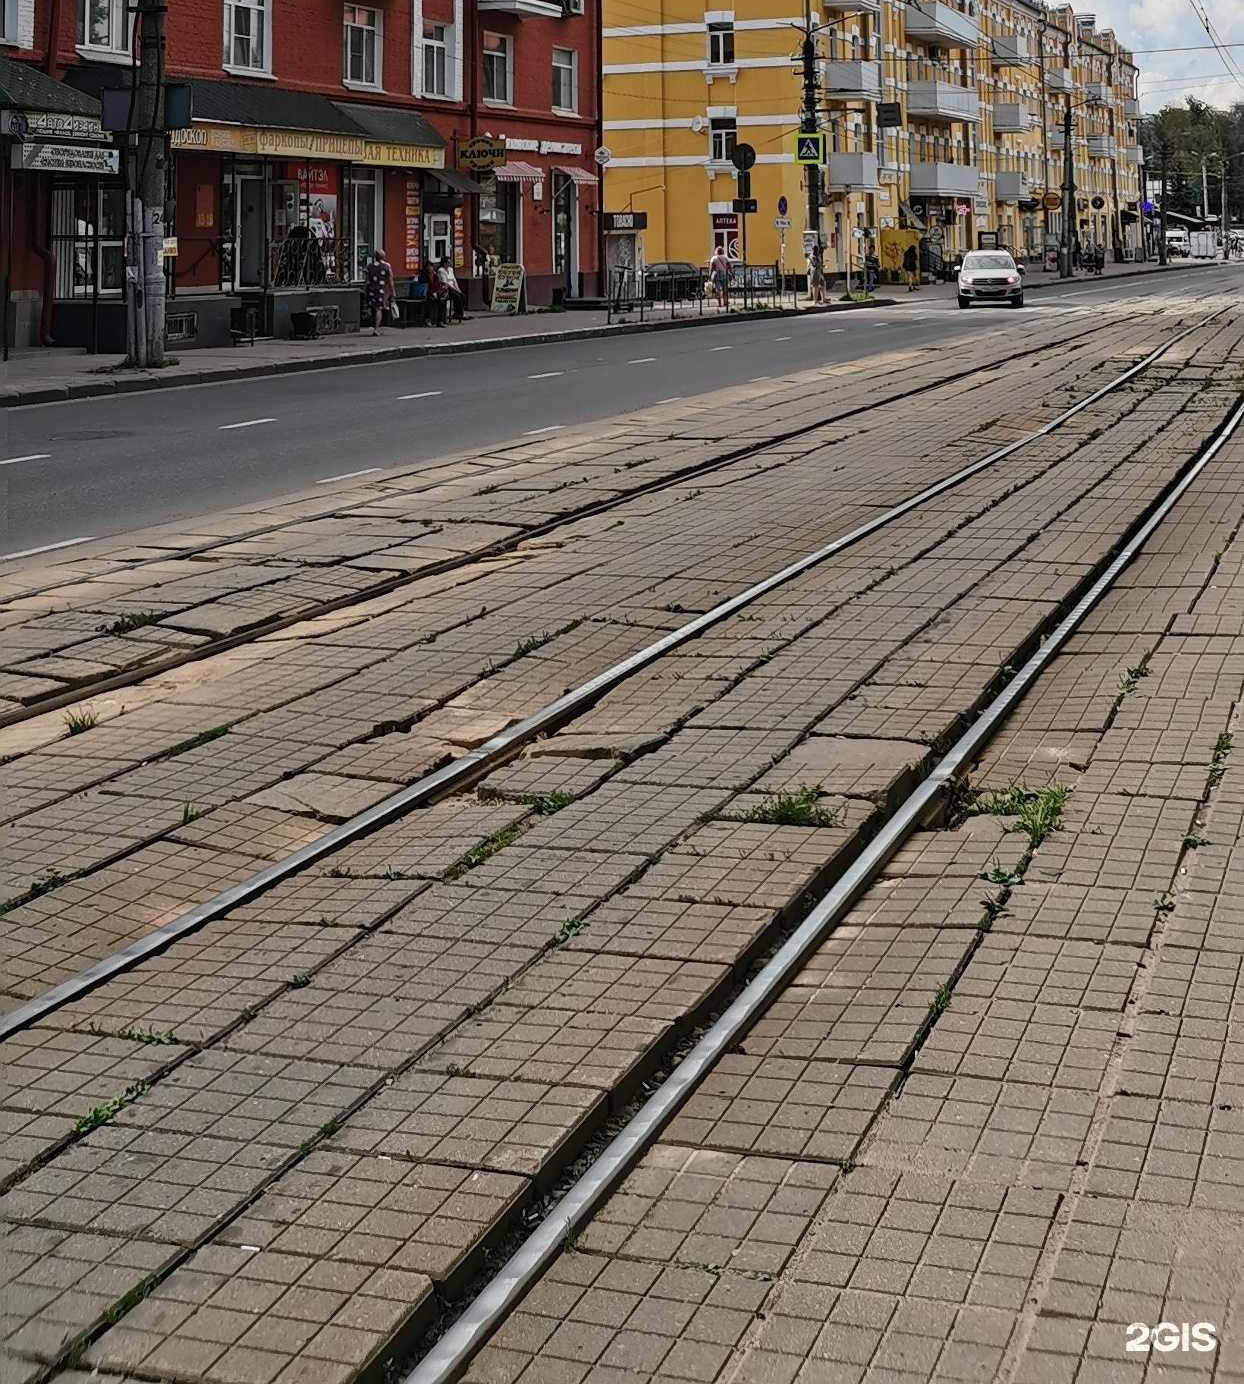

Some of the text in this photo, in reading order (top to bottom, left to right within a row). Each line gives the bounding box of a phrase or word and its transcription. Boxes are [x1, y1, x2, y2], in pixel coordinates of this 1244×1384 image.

[386, 146, 431, 164] ТЕХНИКА
[460, 149, 504, 159] КЛЮЧИ
[716, 217, 736, 225] АПТЕКА
